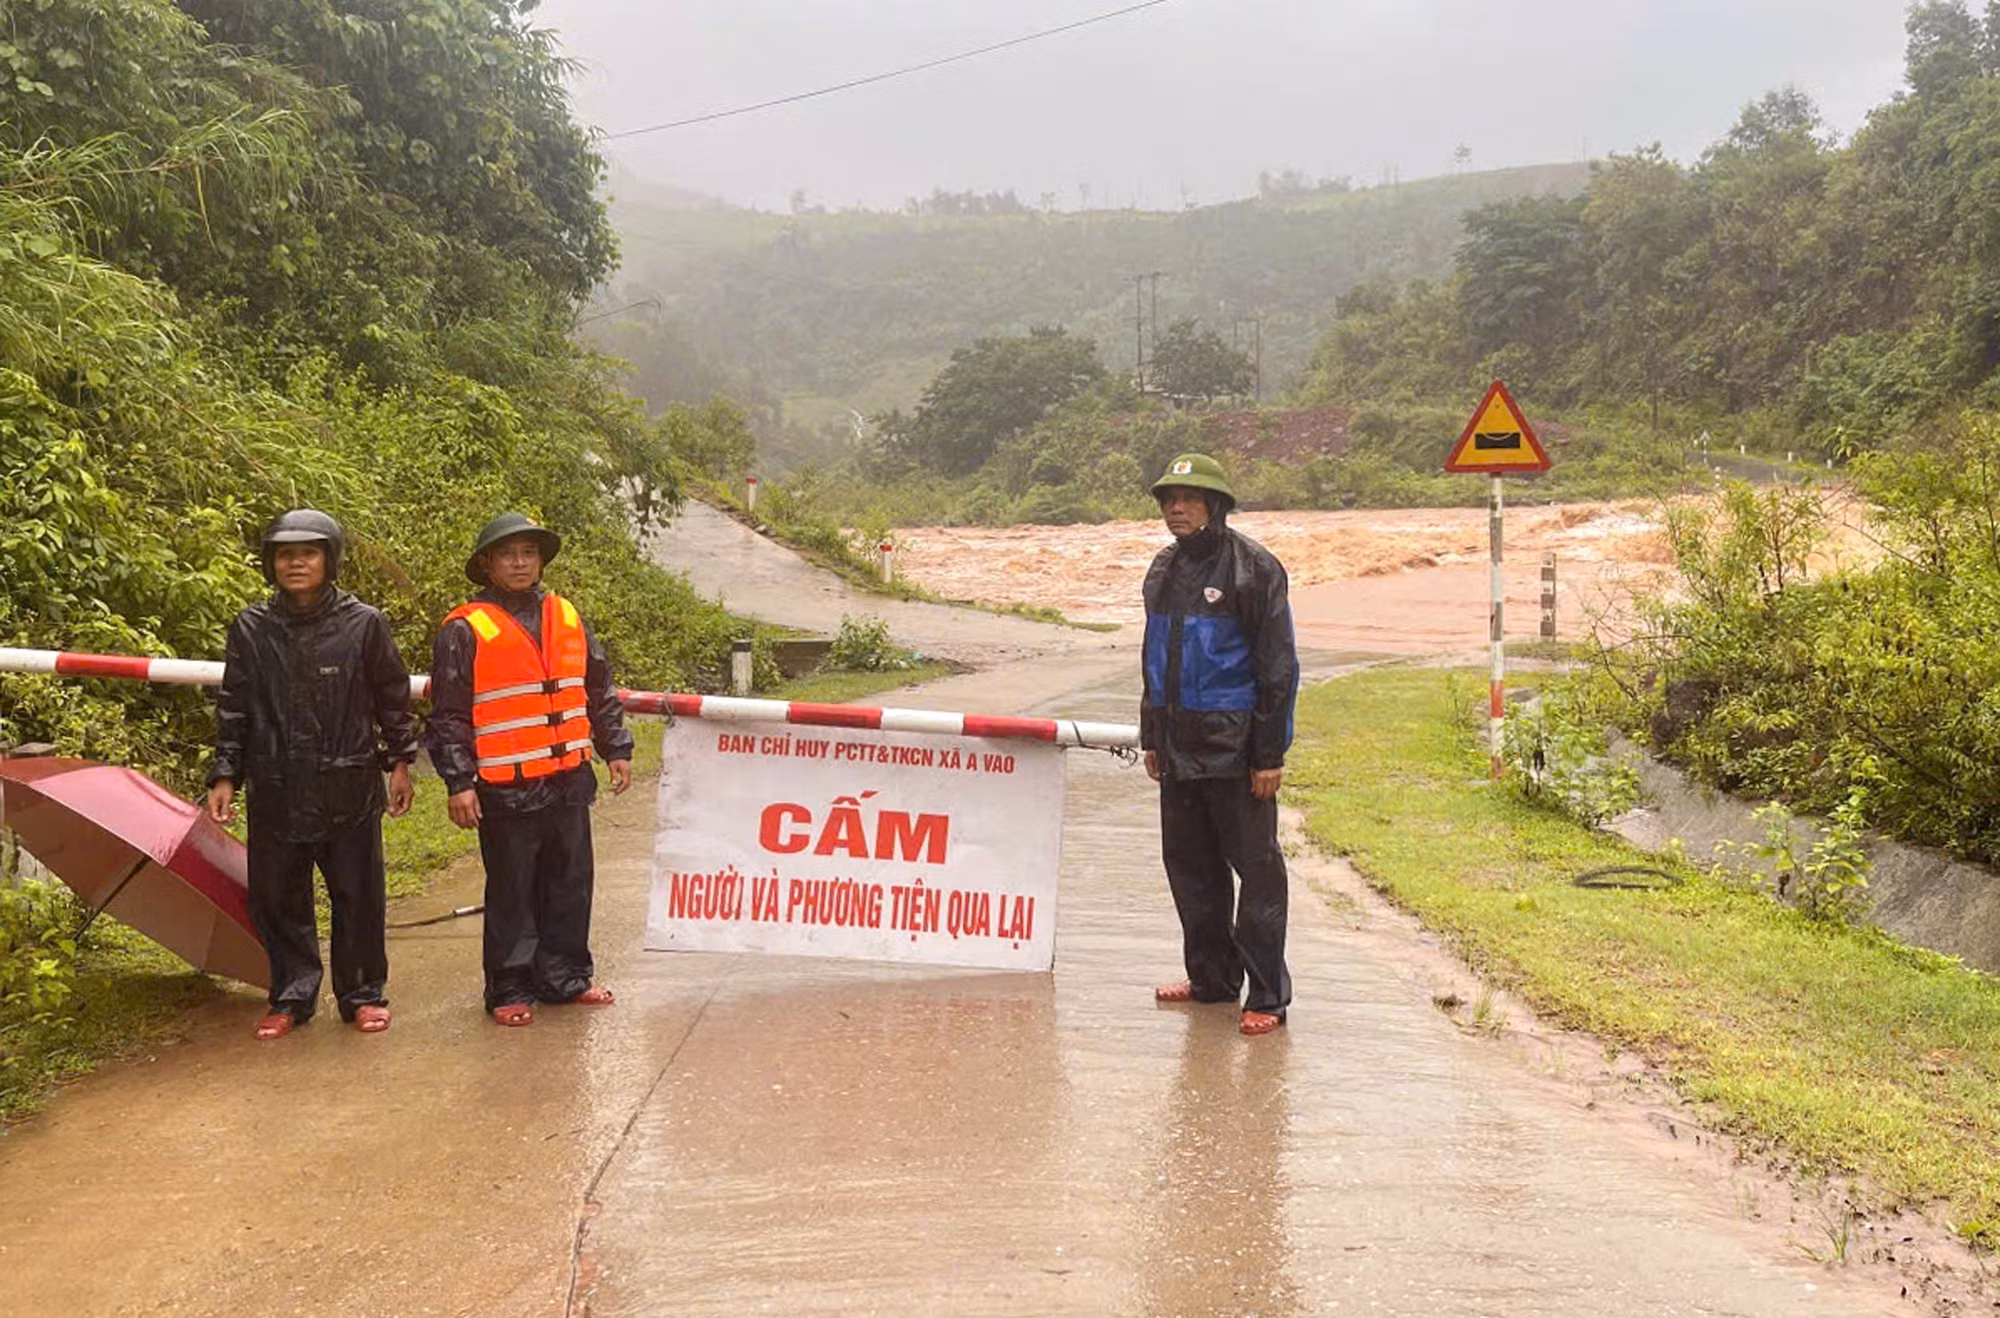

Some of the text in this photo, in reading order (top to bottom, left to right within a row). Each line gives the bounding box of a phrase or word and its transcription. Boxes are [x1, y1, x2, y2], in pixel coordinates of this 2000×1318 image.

[718, 732, 1015, 774] BAN CHỈ HUY PCTT&TKCN XÃ A VAO
[758, 790, 950, 865] CẤM
[668, 864, 1035, 950] NGƯỜI VÀ PHƯƠNG TIỆN QUA LẠI
